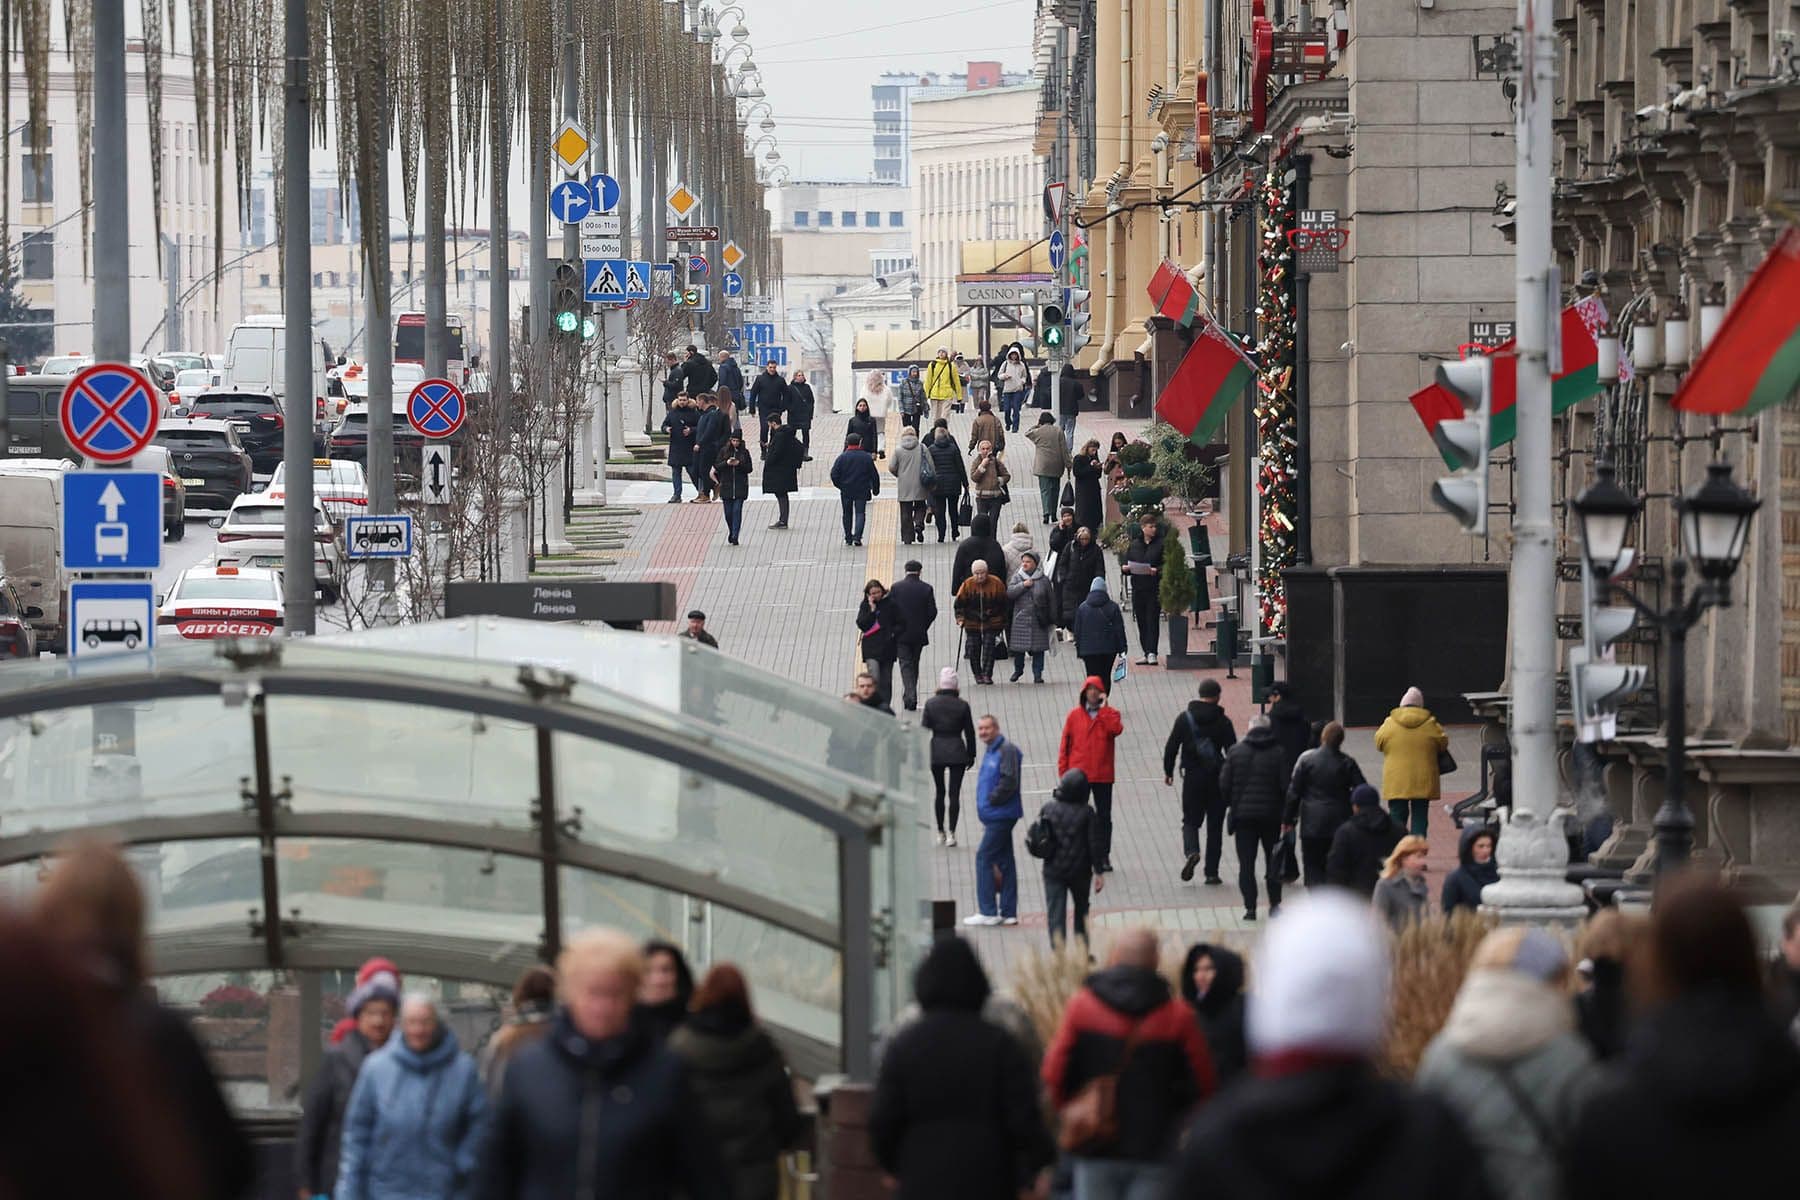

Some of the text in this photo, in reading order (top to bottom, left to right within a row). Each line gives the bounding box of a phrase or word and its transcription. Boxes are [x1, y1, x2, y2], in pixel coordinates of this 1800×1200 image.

[967, 288, 1015, 300] CASINO
[533, 602, 577, 614] Ленина
[181, 623, 271, 636] АВТОСЕТЬ
